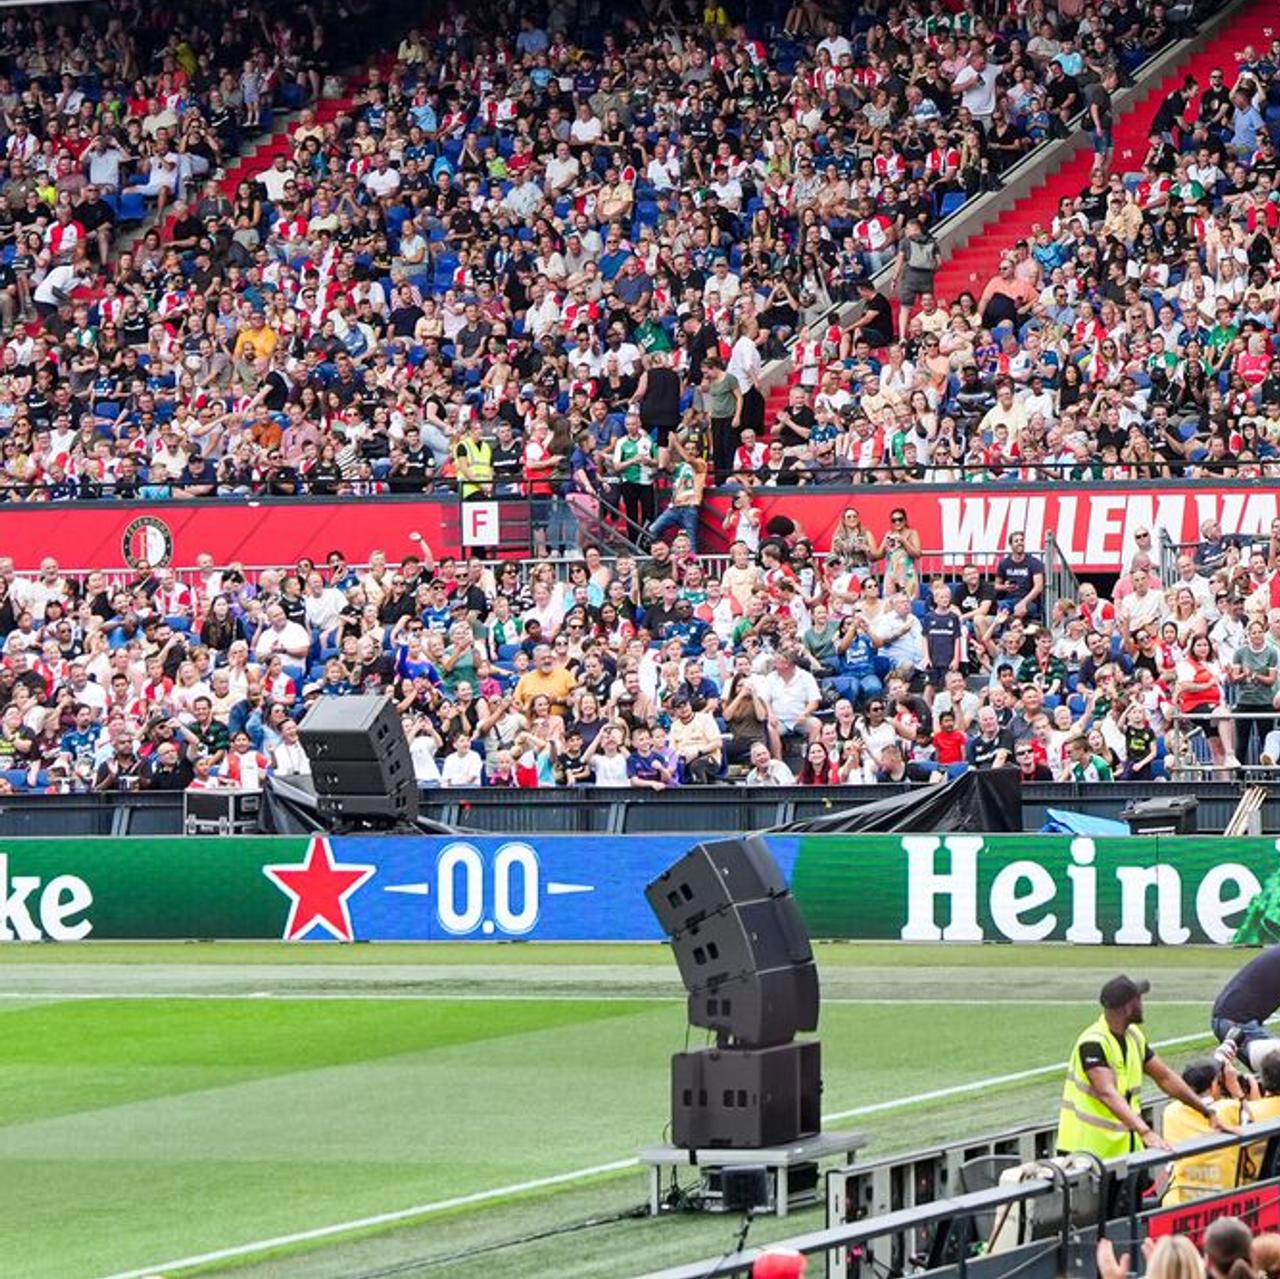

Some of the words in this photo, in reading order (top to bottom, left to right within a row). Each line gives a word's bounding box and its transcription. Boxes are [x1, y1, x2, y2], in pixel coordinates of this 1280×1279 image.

[472, 509, 489, 538] F
[938, 494, 1188, 568] WILLEM
[0, 852, 94, 941] ke
[435, 842, 541, 936] 0.0
[900, 835, 1264, 945] Heine
